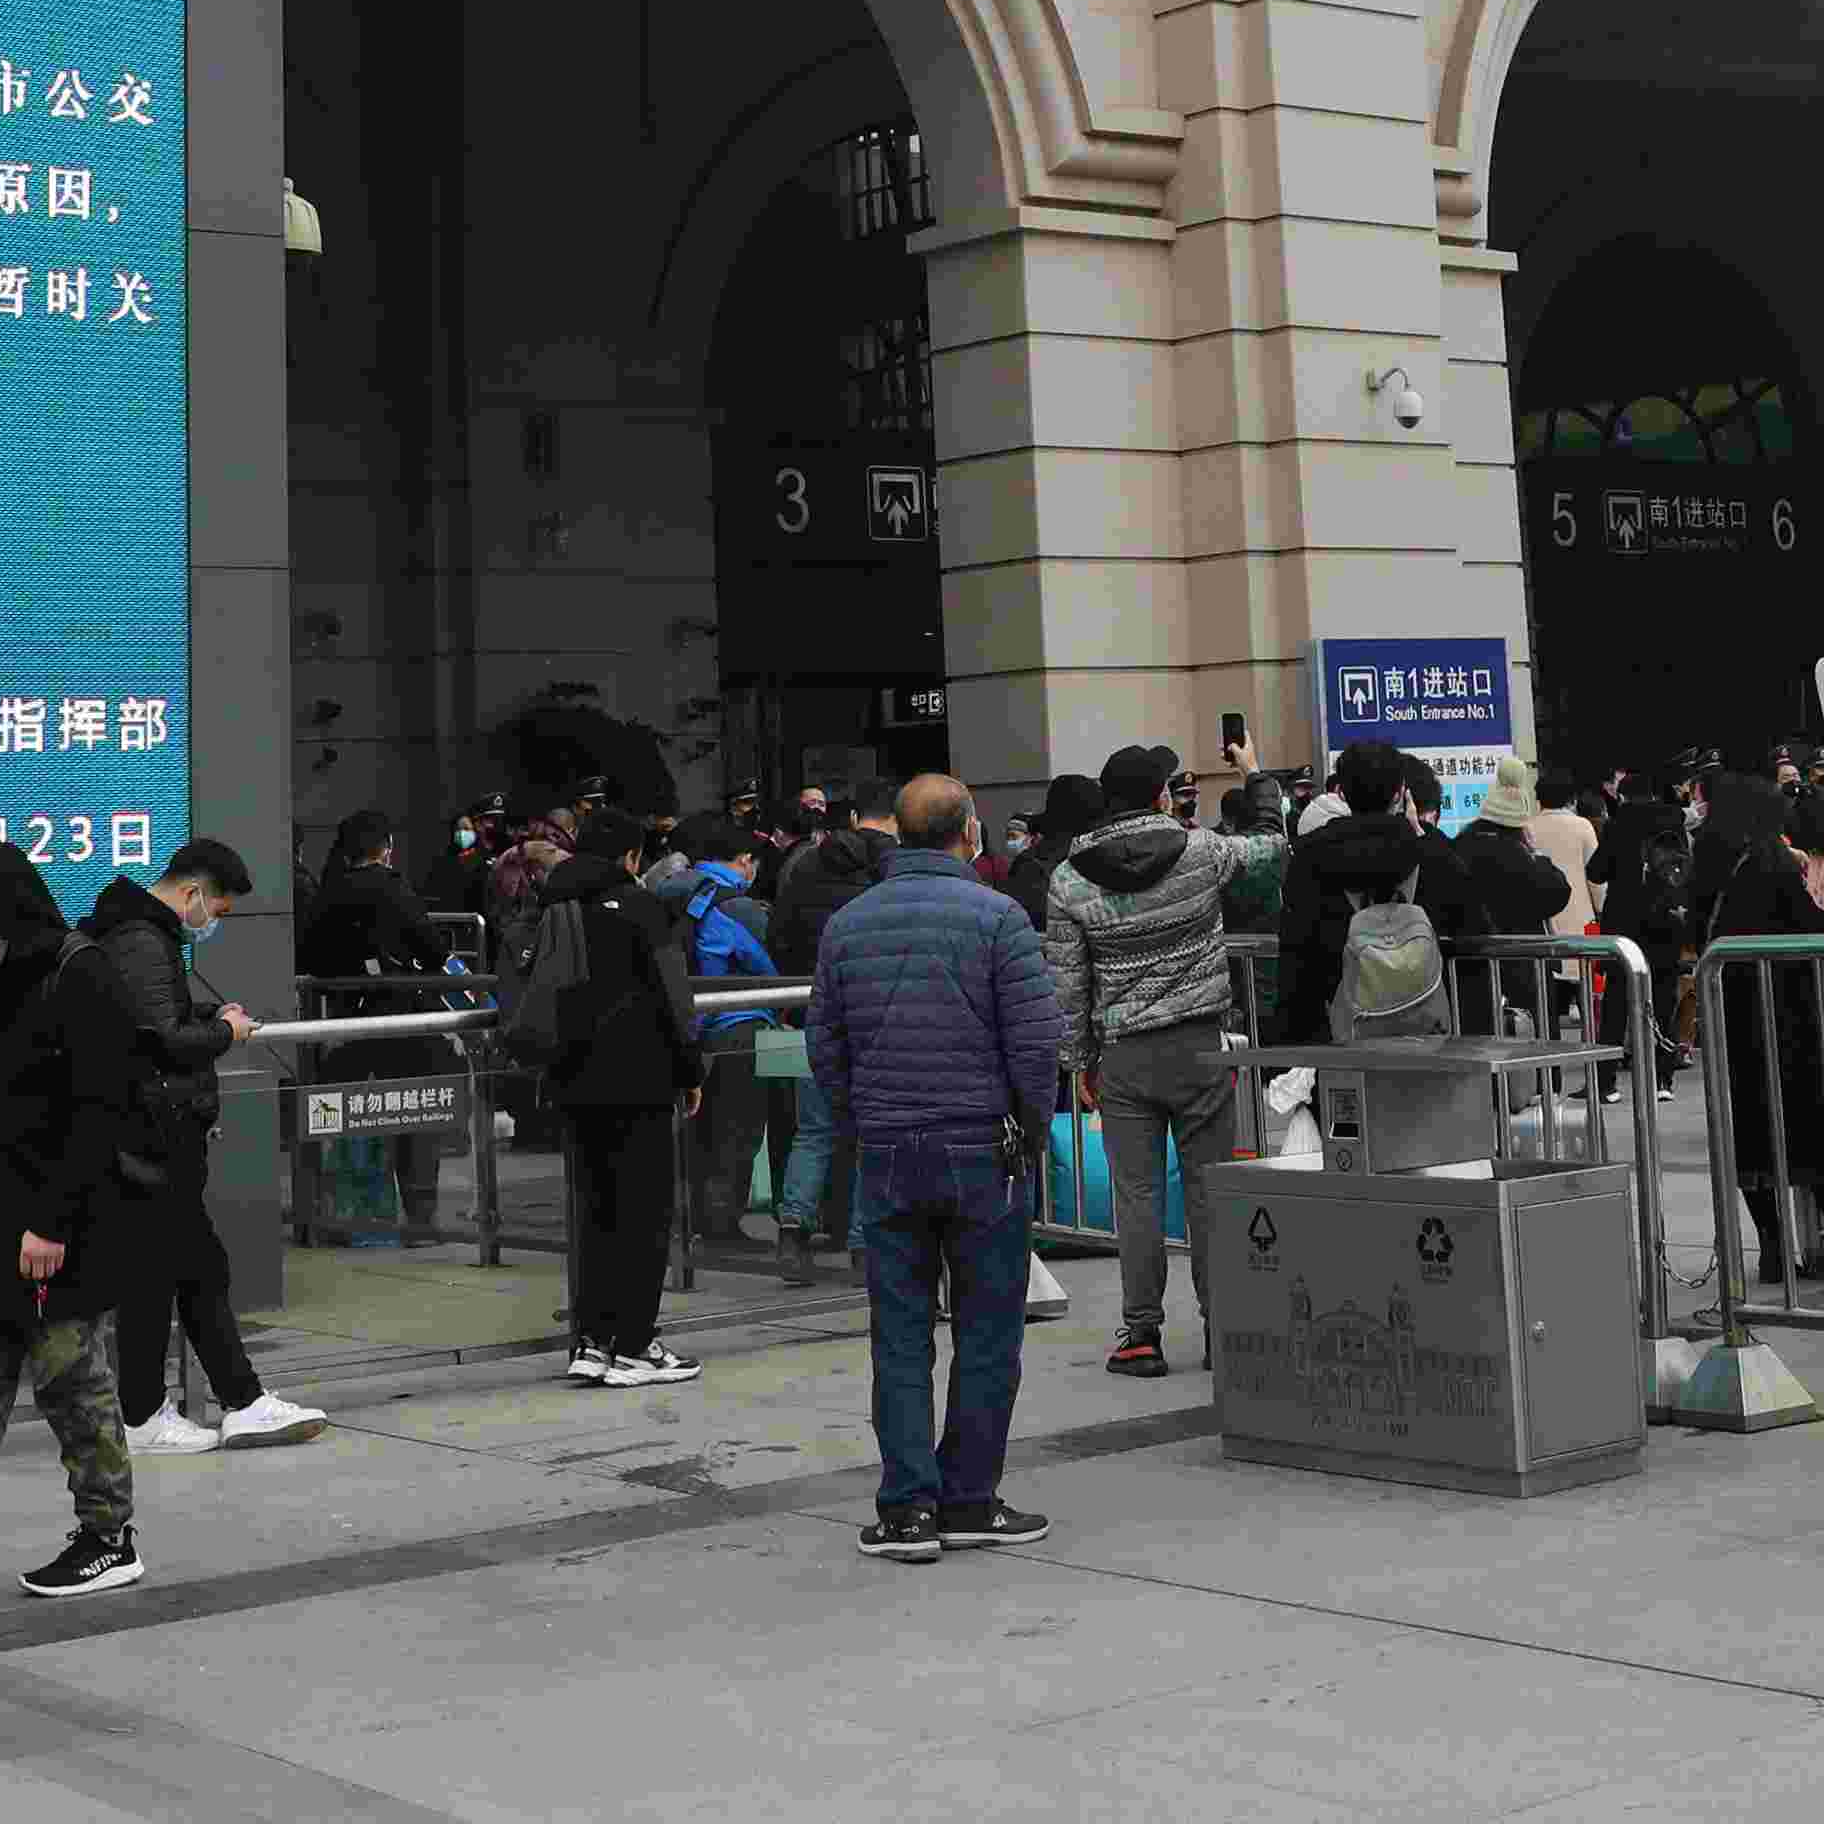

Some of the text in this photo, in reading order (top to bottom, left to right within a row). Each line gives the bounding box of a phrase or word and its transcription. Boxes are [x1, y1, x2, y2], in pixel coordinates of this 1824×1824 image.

[775, 467, 809, 534] 3
[1553, 491, 1576, 547] 5
[1648, 495, 1746, 528] 南1进站口
[1773, 498, 1796, 551] 6
[1383, 666, 1492, 699] 南1进站口
[1385, 702, 1495, 721] South Entrance No.1
